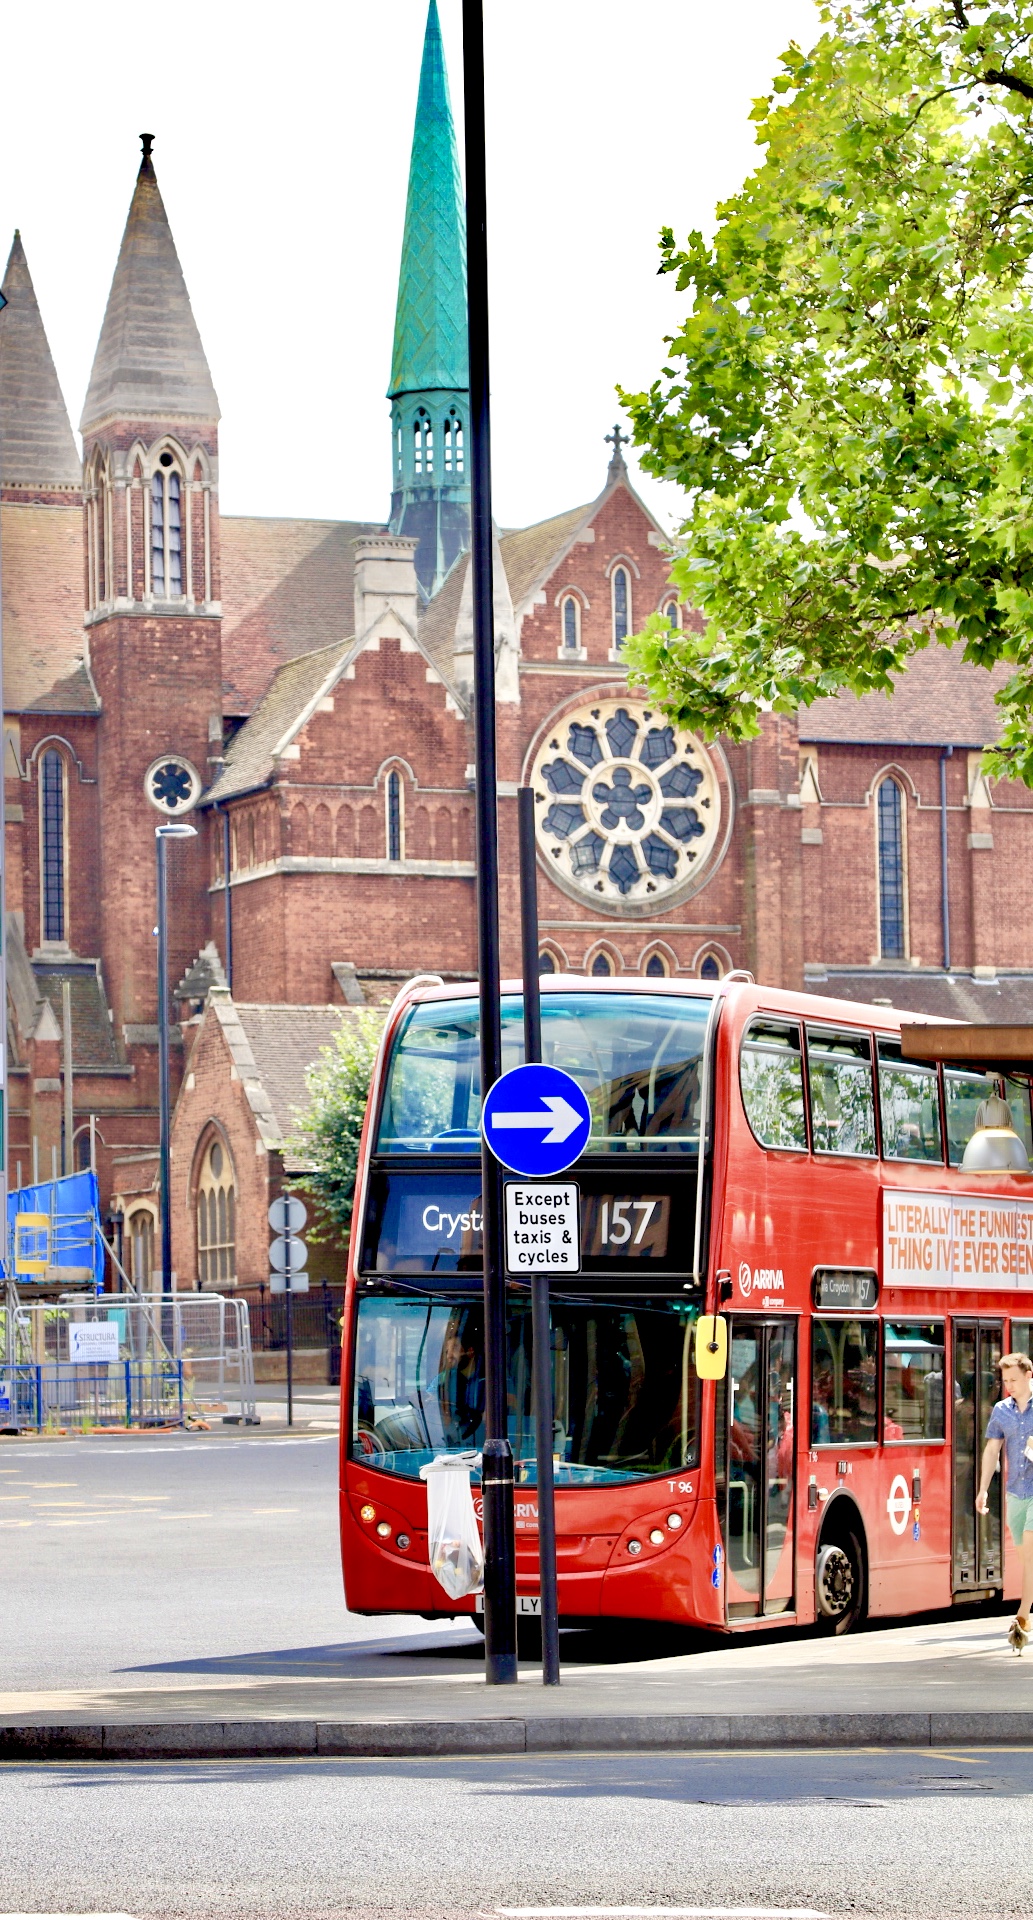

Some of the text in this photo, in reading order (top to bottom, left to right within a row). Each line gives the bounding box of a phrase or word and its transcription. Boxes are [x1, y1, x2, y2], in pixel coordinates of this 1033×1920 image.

[515, 1191, 570, 1208] Except
[422, 1205, 484, 1239] Cryst
[519, 1210, 566, 1225] buses
[601, 1201, 657, 1245] 157
[953, 1209, 976, 1237] THE
[979, 1210, 1033, 1240] FUNNIEST
[513, 1229, 572, 1244] taxis &
[518, 1249, 569, 1266] cycles
[888, 1237, 1033, 1275] THING I'VE EVER SEEN
[752, 1269, 785, 1290] ARRIVA
[829, 1279, 851, 1297] Croydon
[667, 1481, 693, 1494] T 96
[513, 1503, 539, 1518] RIV
